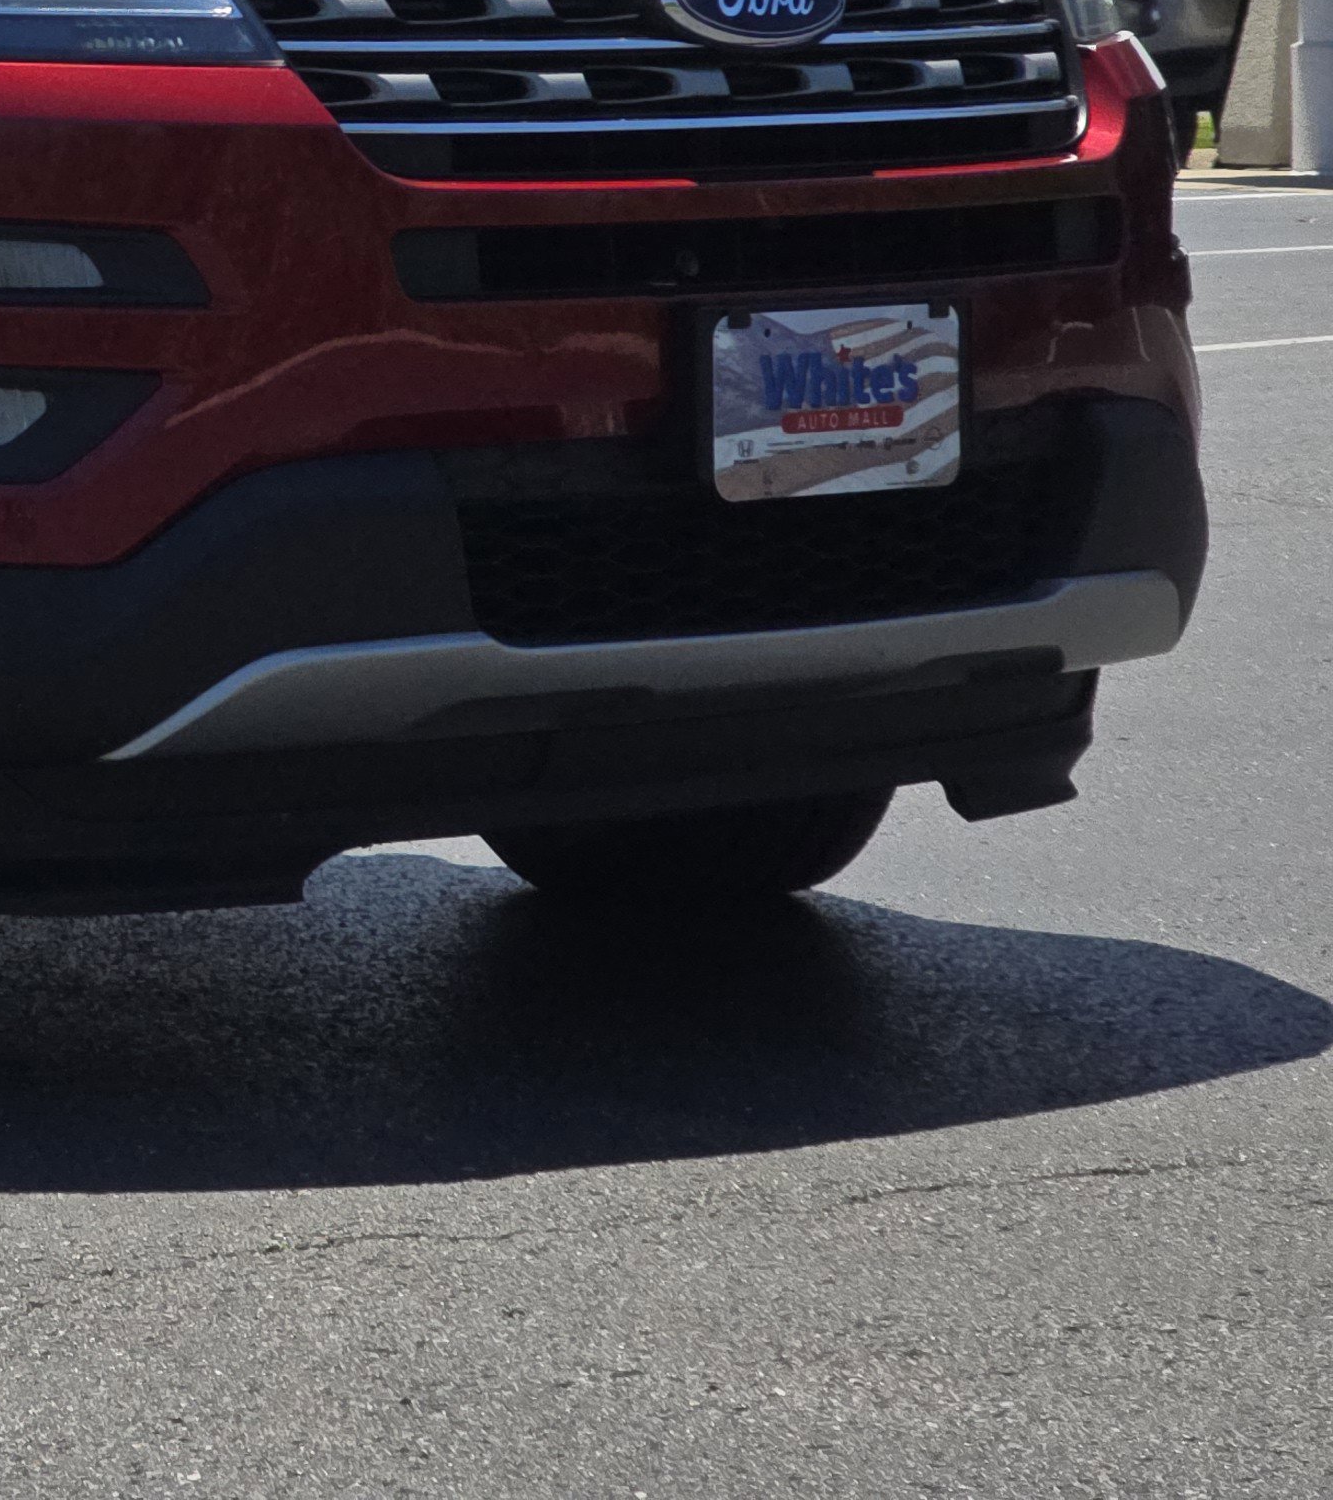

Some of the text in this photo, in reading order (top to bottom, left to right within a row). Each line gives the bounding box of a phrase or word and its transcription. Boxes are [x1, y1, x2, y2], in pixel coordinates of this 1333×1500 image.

[759, 347, 919, 410] White's
[797, 410, 888, 431] AUTO MALL
